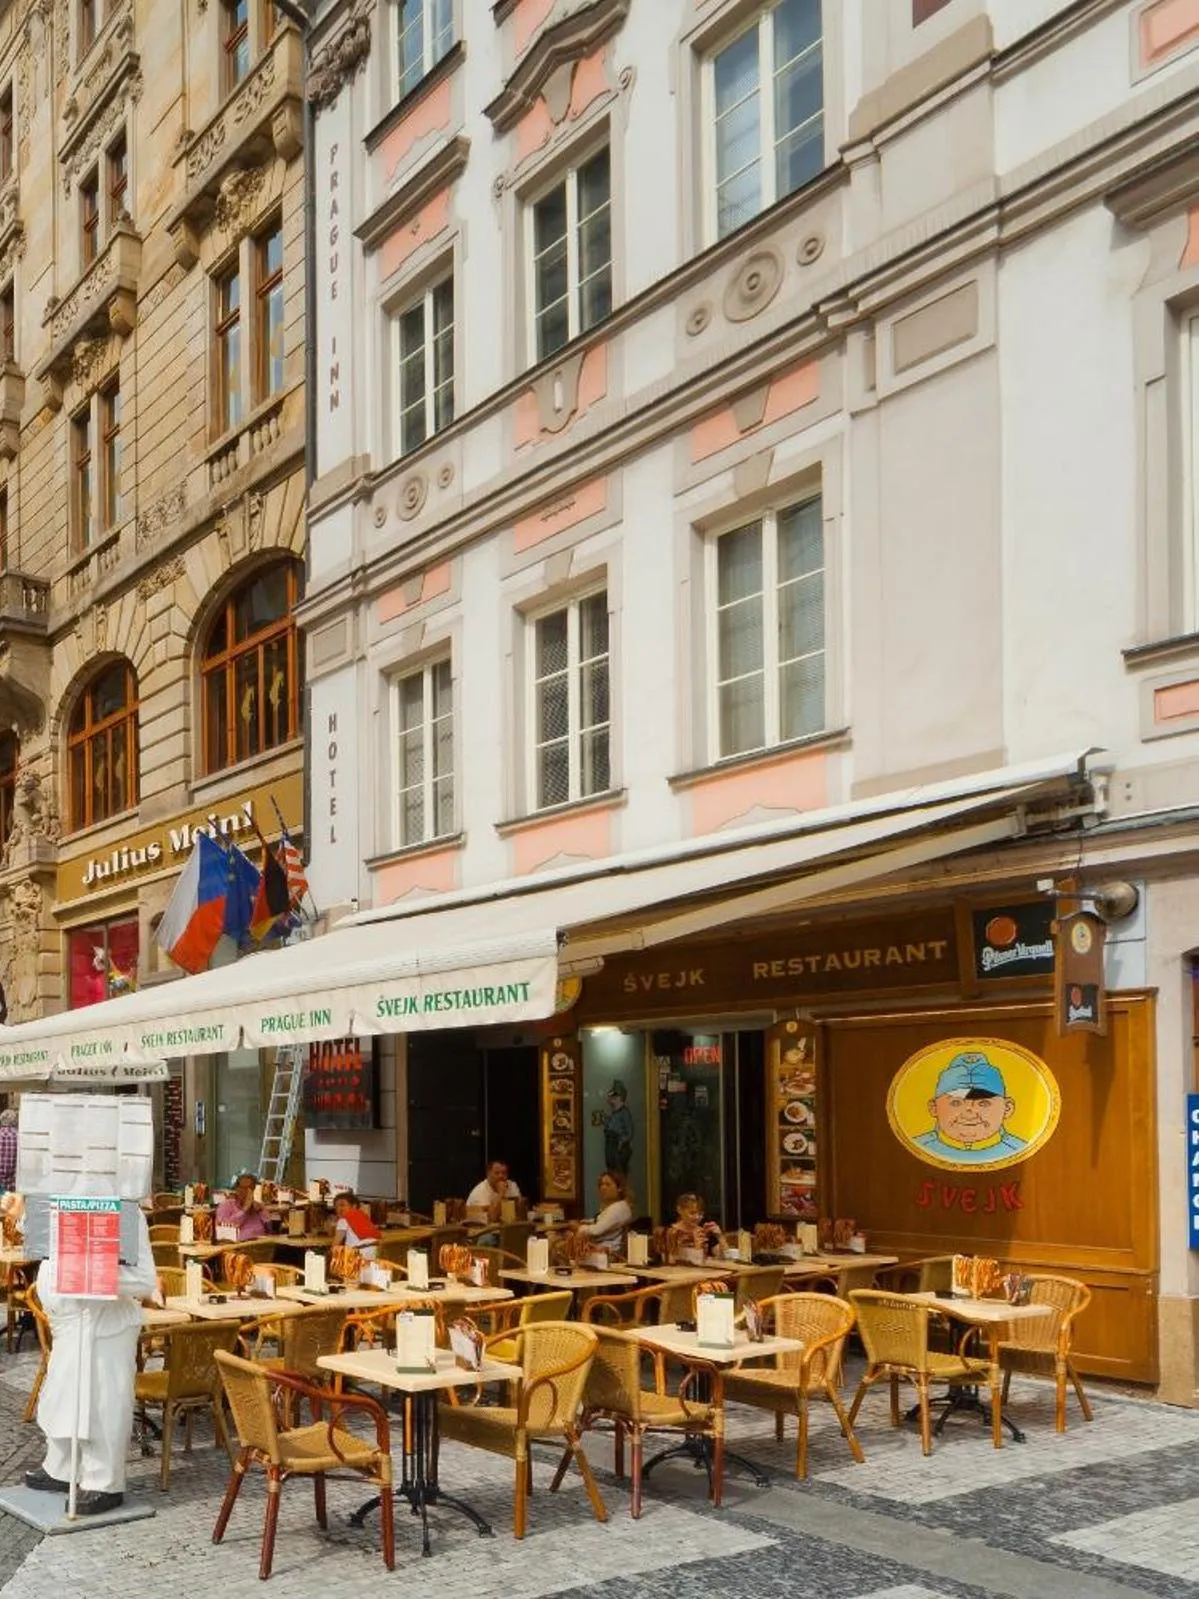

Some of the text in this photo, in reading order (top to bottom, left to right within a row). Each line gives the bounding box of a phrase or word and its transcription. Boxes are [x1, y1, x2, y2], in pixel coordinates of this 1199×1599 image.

[329, 142, 340, 413] PRAGUE INN
[328, 712, 338, 844] HOTEL
[82, 841, 161, 885] Julius
[753, 940, 948, 980] RESTAURANT
[424, 982, 531, 1012] RESTAURANT
[261, 1008, 331, 1033] PRAGUE INN
[309, 1037, 362, 1073] HOTEL
[683, 1046, 721, 1065] OPEN
